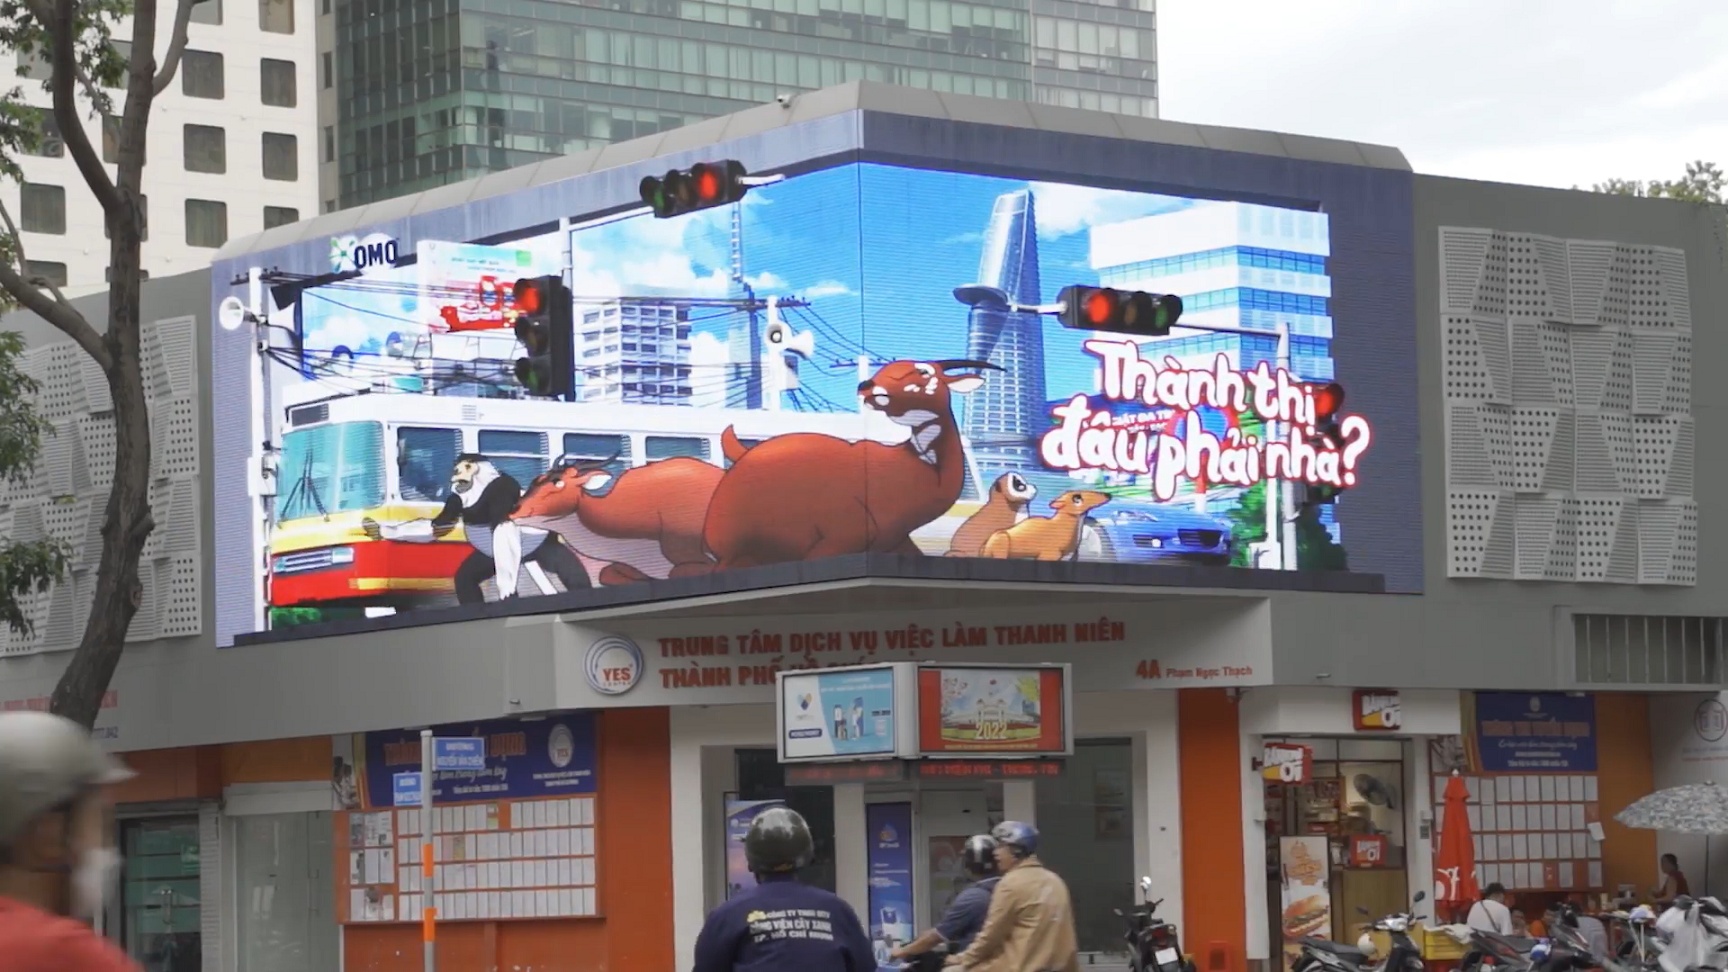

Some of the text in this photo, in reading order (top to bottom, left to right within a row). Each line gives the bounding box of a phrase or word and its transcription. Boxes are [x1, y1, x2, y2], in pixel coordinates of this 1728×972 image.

[354, 240, 398, 269] OMO
[1085, 340, 1316, 437] Thành thị
[1042, 394, 1371, 500] đâu phải nhà?
[658, 621, 1125, 657] TRUNG TÂM DỊCH VỤ VIỆC LÀM THANH NIÊN
[603, 667, 631, 681] YES
[659, 661, 731, 689] THÀNH
[1136, 659, 1253, 681] 4A Phạm Ngọc Thạch
[975, 722, 1008, 740] 2022
